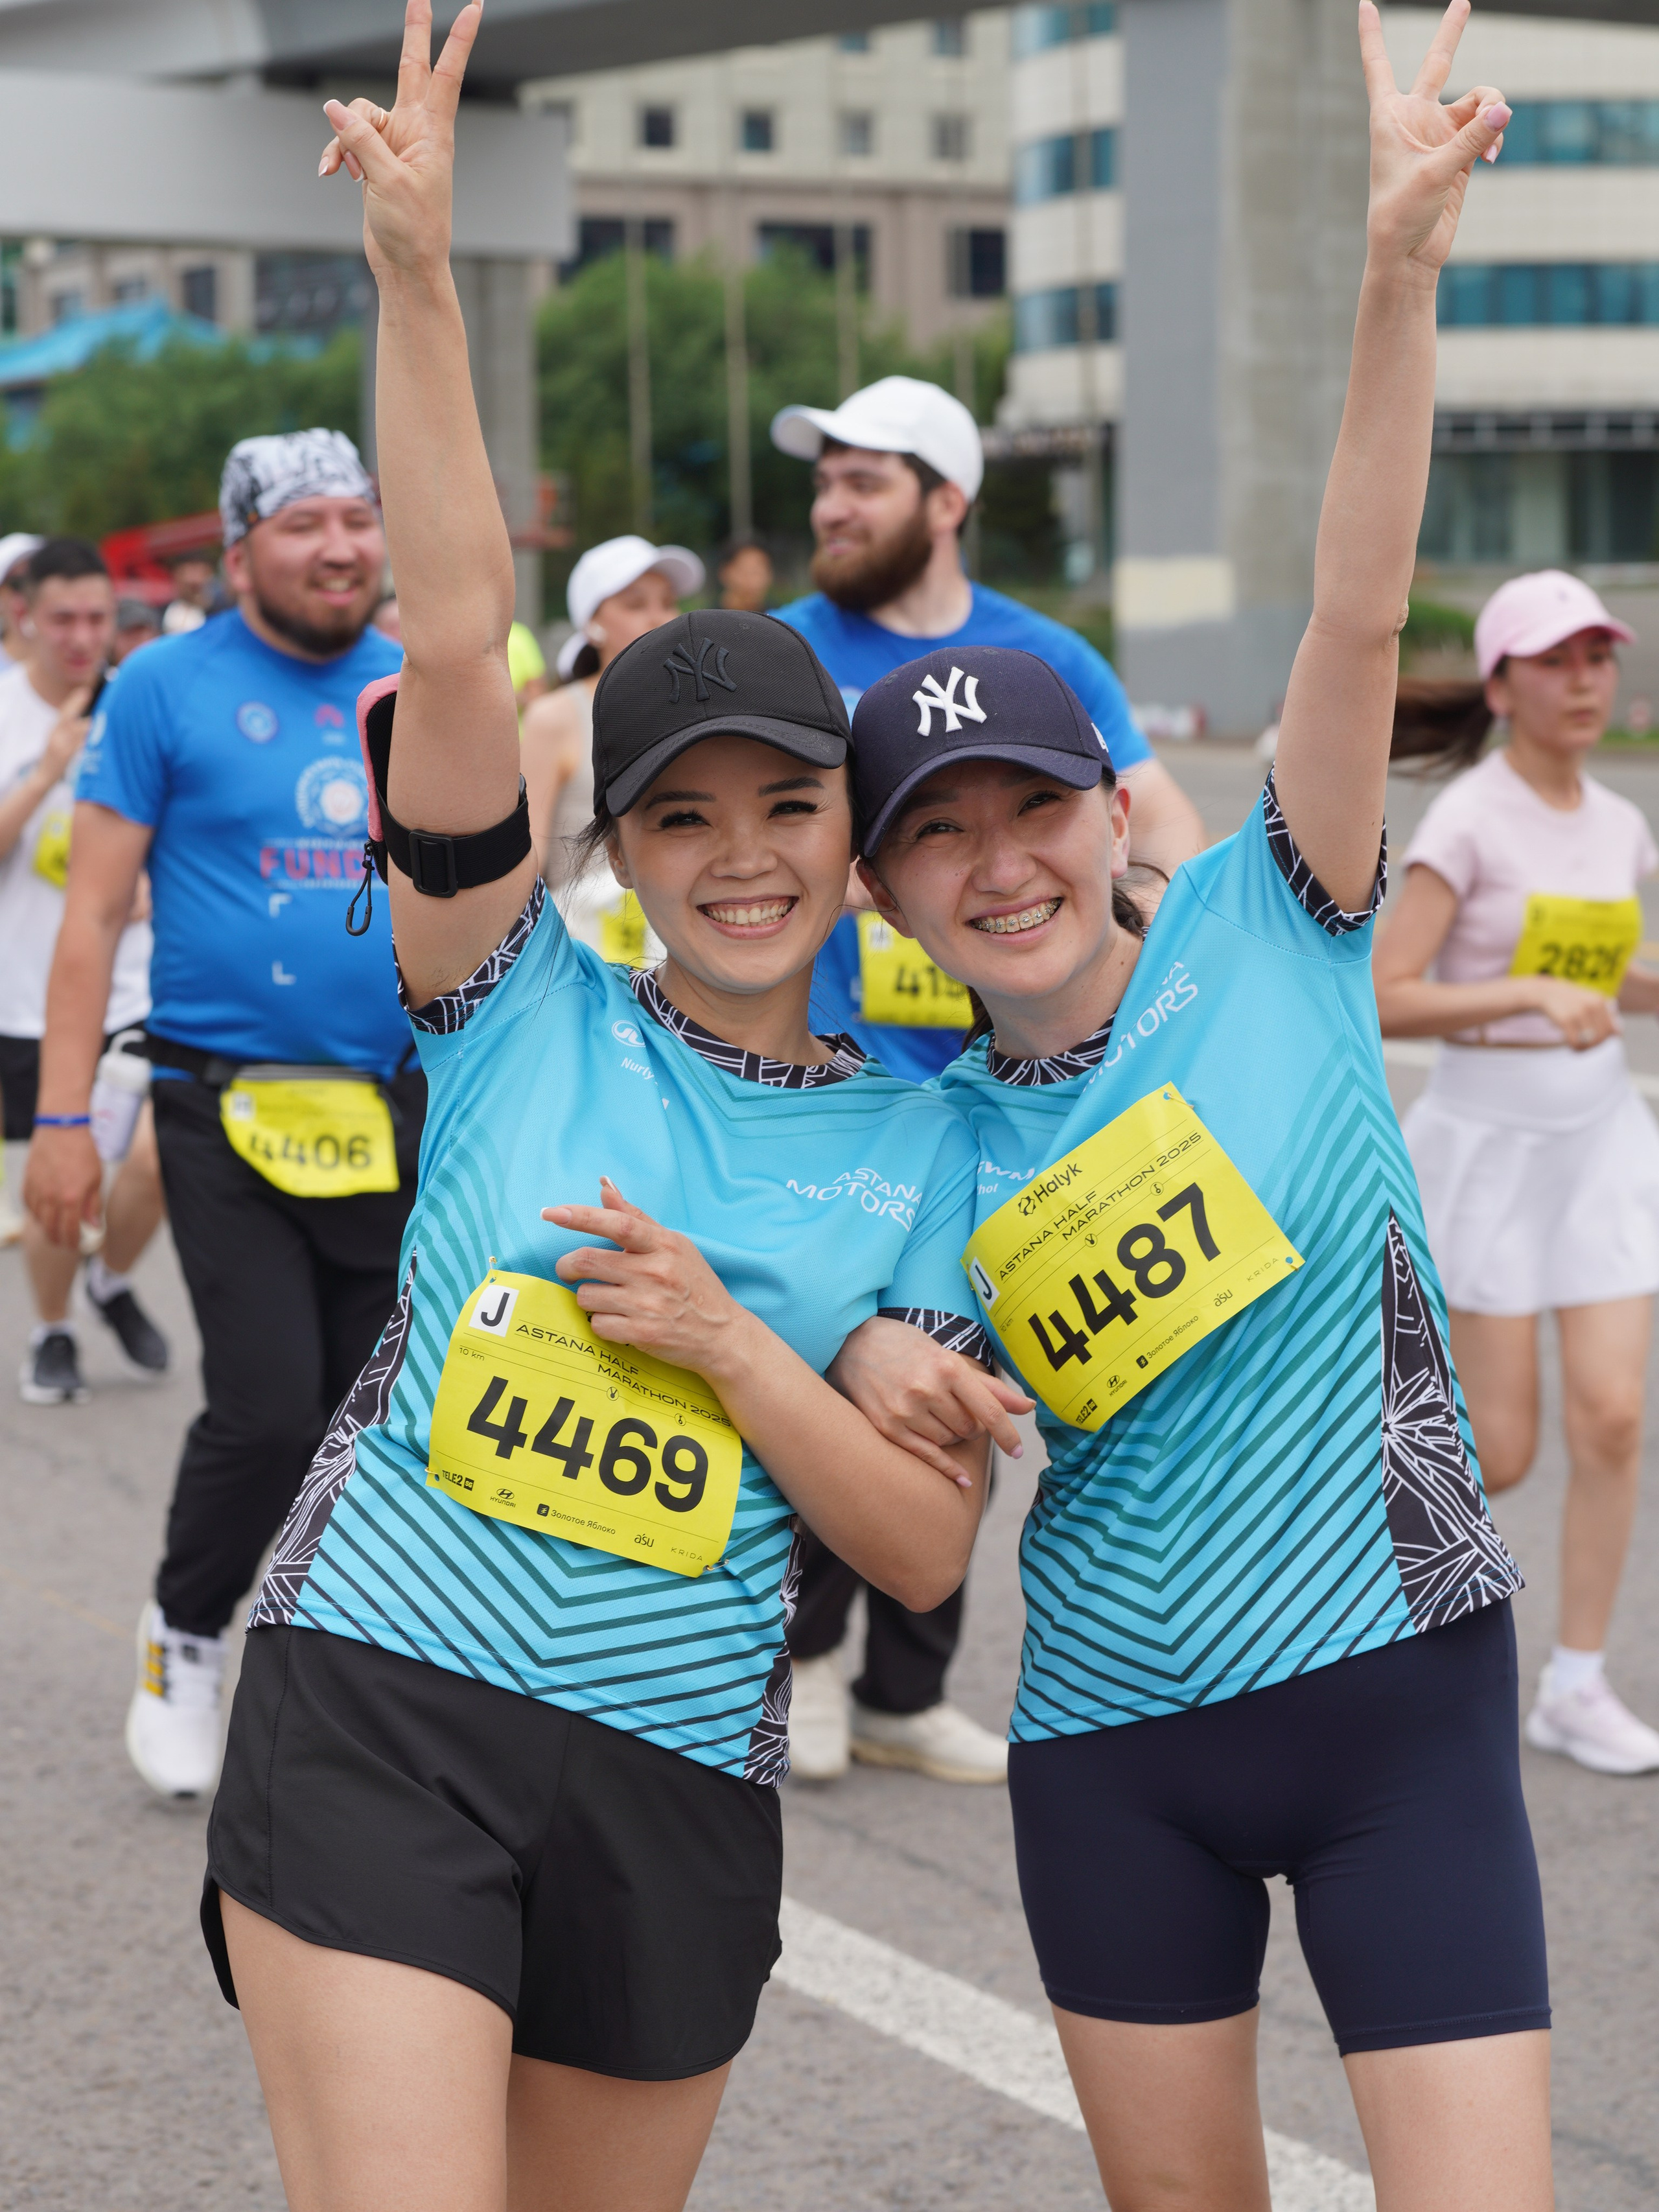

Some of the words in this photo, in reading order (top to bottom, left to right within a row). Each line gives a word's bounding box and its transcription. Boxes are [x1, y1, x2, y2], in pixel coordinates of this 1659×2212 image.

[249, 1134, 371, 1170] 4406
[833, 1167, 922, 1205] ASTANA
[977, 1183, 999, 1195] hol
[1034, 1163, 1083, 1203] Halyk
[1062, 1165, 1155, 1241] MARATHON
[1156, 1132, 1201, 1167] 2025
[785, 1179, 915, 1232] MOTORS
[999, 1229, 1053, 1281] ASTANA
[1054, 1190, 1096, 1229] HALF
[975, 1264, 992, 1300] J
[1028, 1182, 1221, 1372] 4487
[1247, 1258, 1279, 1282] KRIDA
[481, 1292, 510, 1327] J
[459, 1347, 469, 1355] 10
[471, 1351, 485, 1361] km
[516, 1324, 596, 1356] ASTANA
[600, 1350, 639, 1375] HALF
[1146, 1335, 1174, 1359] Золотое
[1173, 1316, 1199, 1337] Яблоко
[597, 1364, 687, 1410] MARATHON
[690, 1405, 731, 1427] 2025
[1109, 1379, 1128, 1397] HYUNDAI
[467, 1376, 708, 1513] 4469
[442, 1470, 463, 1486] TELE2
[490, 1496, 516, 1508] HYUNDAI
[551, 1509, 585, 1526] Золотое
[586, 1520, 616, 1535] Яблоко
[671, 1546, 703, 1562] KRIDA
